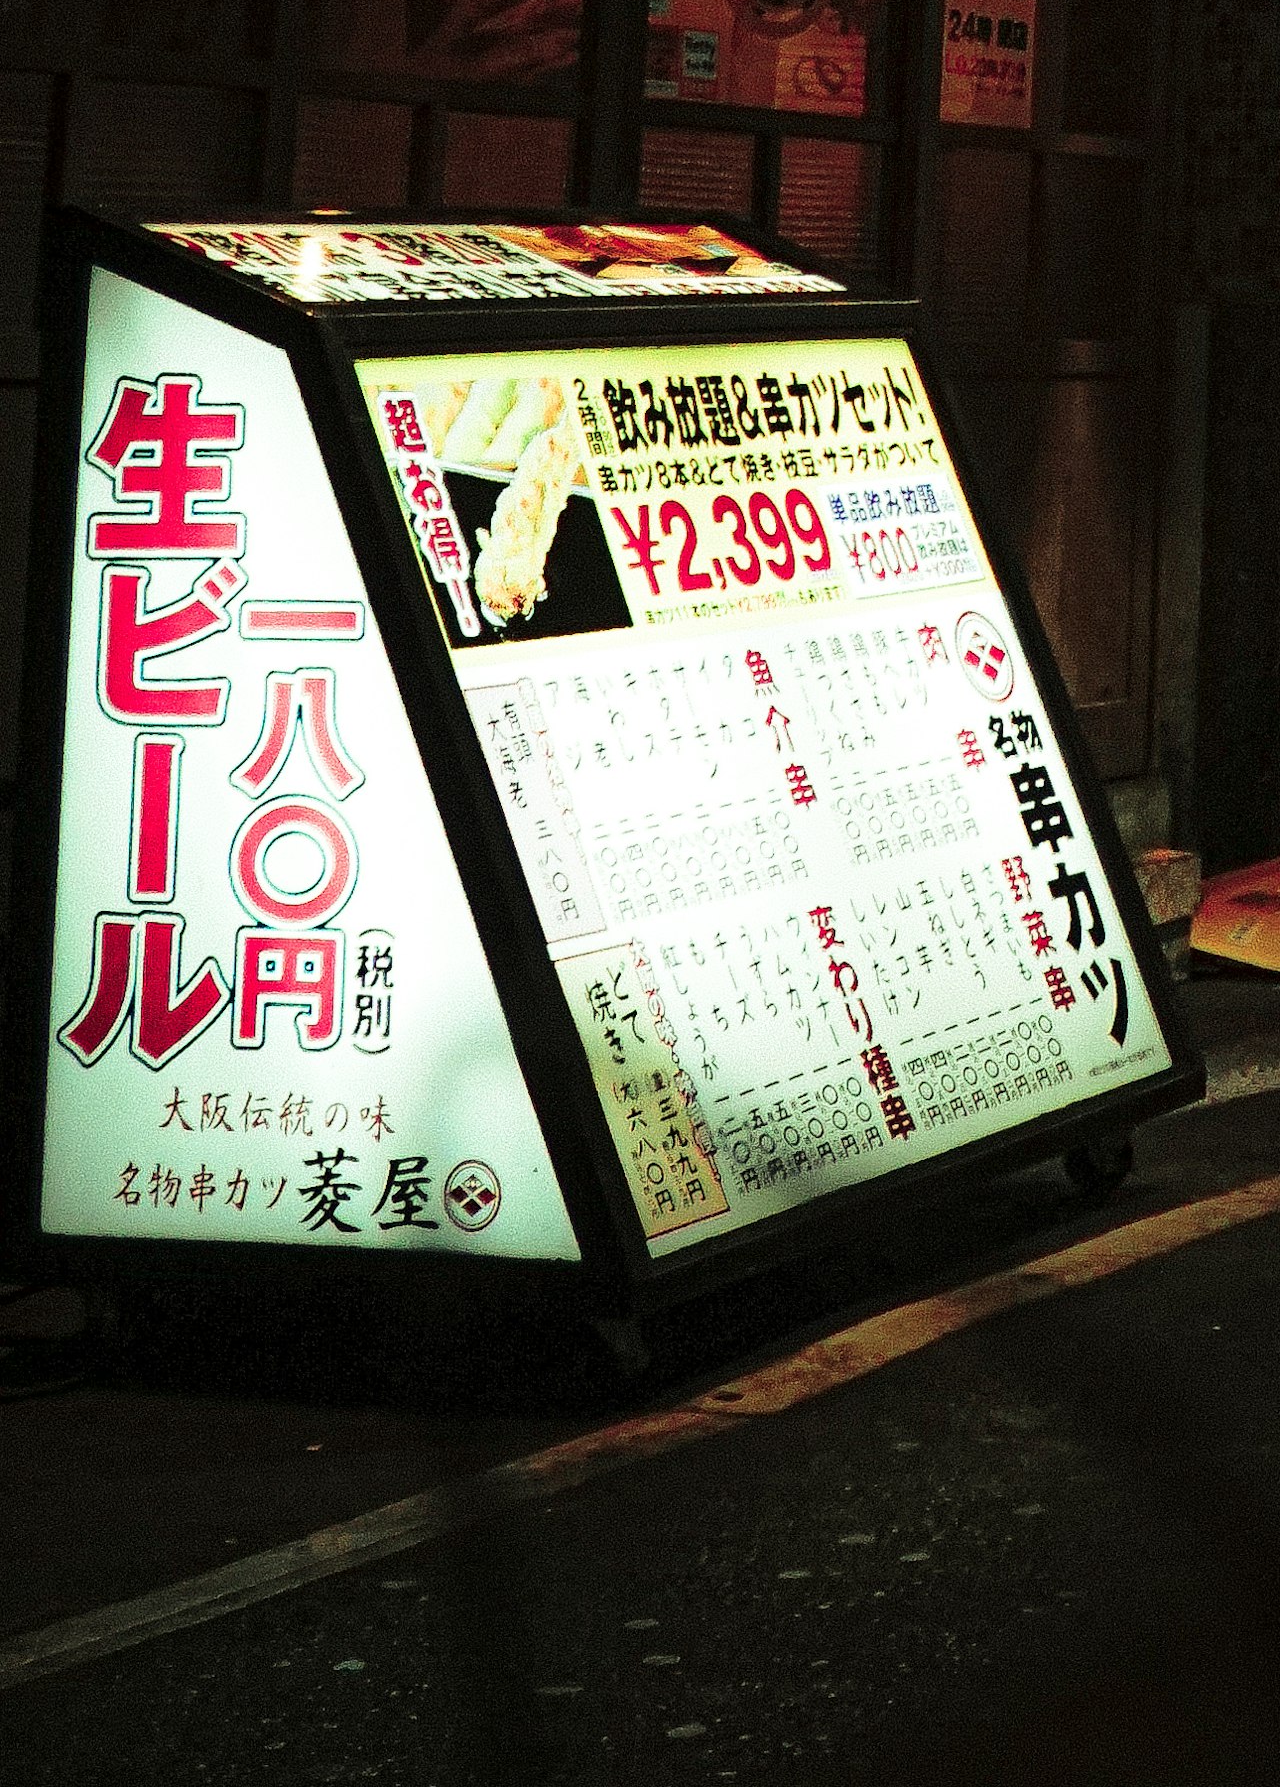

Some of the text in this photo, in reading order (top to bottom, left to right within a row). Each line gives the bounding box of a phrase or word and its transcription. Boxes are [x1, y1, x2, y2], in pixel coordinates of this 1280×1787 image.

[564, 376, 612, 457] 2時間
[604, 367, 926, 453] 飲み放題&串カツセット!
[610, 488, 831, 596] ¥2,399
[827, 483, 940, 526] 単品飲み放題
[841, 527, 919, 584] ¥800
[58, 371, 247, 1072] 生ビール
[744, 649, 817, 807] 魚介串
[987, 709, 1043, 758] 名物
[227, 598, 368, 1054] 一八〇円
[872, 895, 921, 1009] レンコン
[895, 888, 933, 973] 山芋
[915, 879, 953, 966] 玉ねぎ
[939, 880, 987, 990] ししとう
[959, 869, 996, 952] 白ネギ
[981, 864, 1032, 982] さつまいも
[1000, 854, 1076, 1011] 野菜串
[1008, 763, 1128, 1043] 串カツ
[352, 929, 394, 1058] (税別)
[687, 939, 730, 1031] もち
[713, 931, 755, 1024] チーズ
[739, 925, 779, 1018] うずら
[763, 928, 812, 1042] ハムカツ
[849, 899, 899, 1015] しいたけ
[584, 961, 644, 1063] どて 焼き
[659, 944, 718, 1080] 紅しょうが
[808, 905, 914, 1136] 変わり種串
[159, 1087, 395, 1140] 大阪伝統の味
[117, 1150, 442, 1233] 名物串カツ 菱屋
